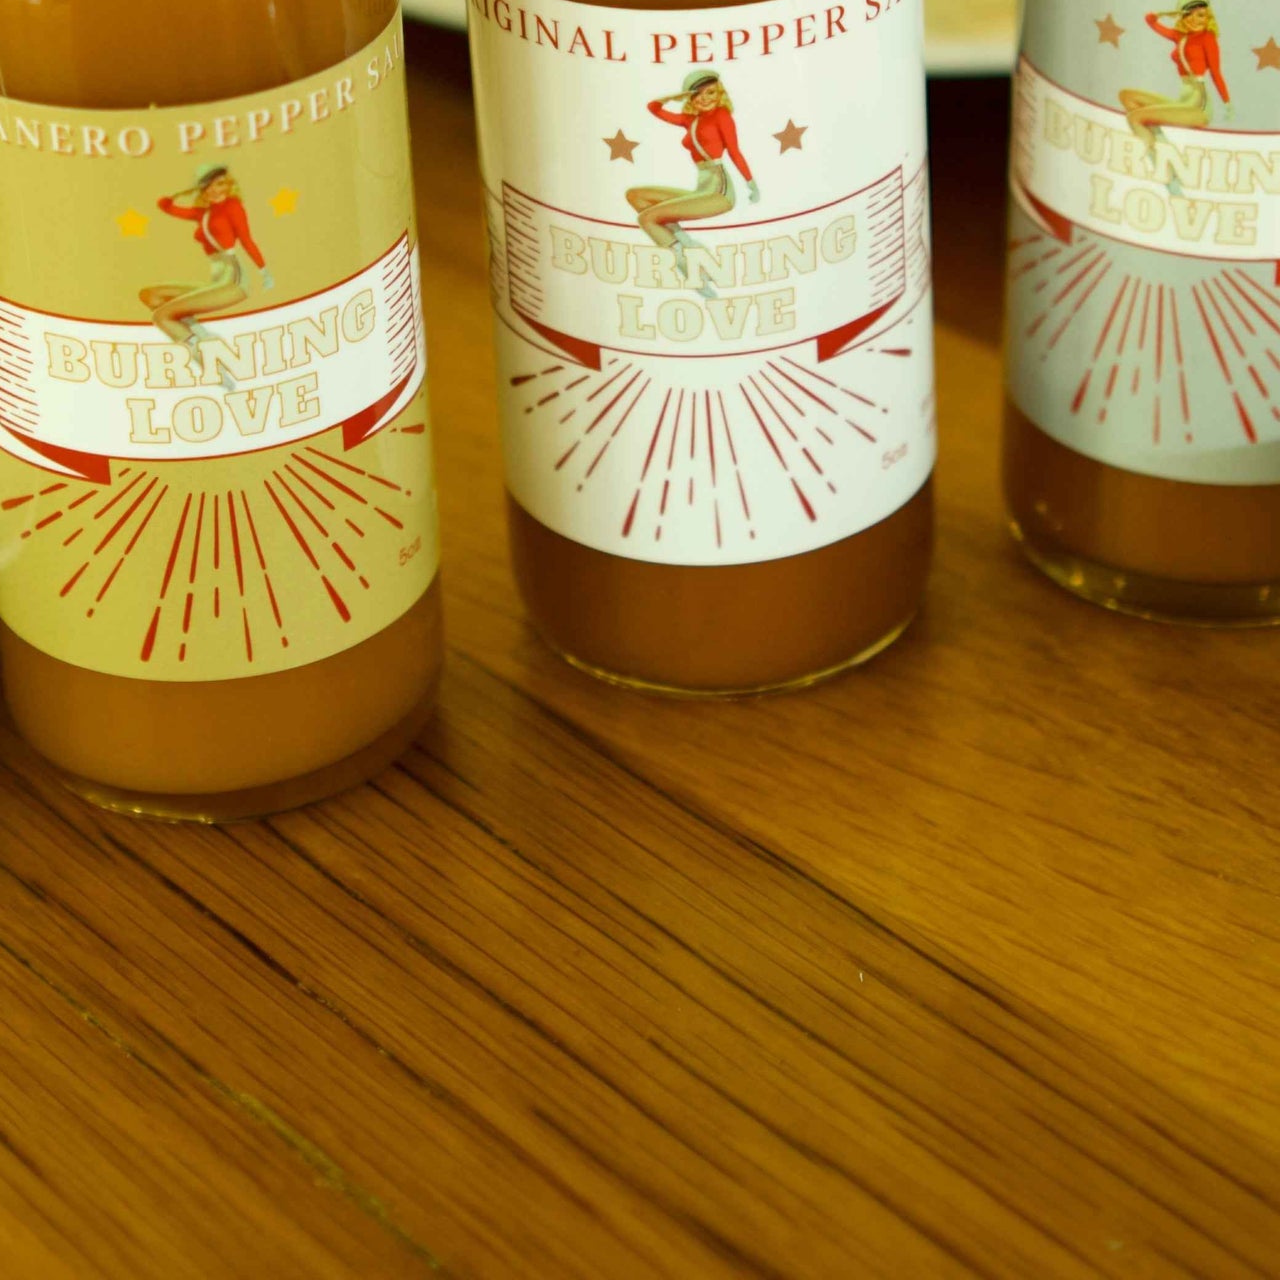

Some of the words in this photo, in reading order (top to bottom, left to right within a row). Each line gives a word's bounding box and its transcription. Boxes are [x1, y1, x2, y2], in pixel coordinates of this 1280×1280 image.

[651, 5, 848, 64] PEPPER
[178, 77, 355, 153] PEPPER
[1088, 174, 1259, 246] LOVE
[549, 215, 858, 290] BURNING
[45, 289, 377, 388] BURNING
[617, 287, 796, 342] LOVE
[126, 373, 321, 443] LOVE
